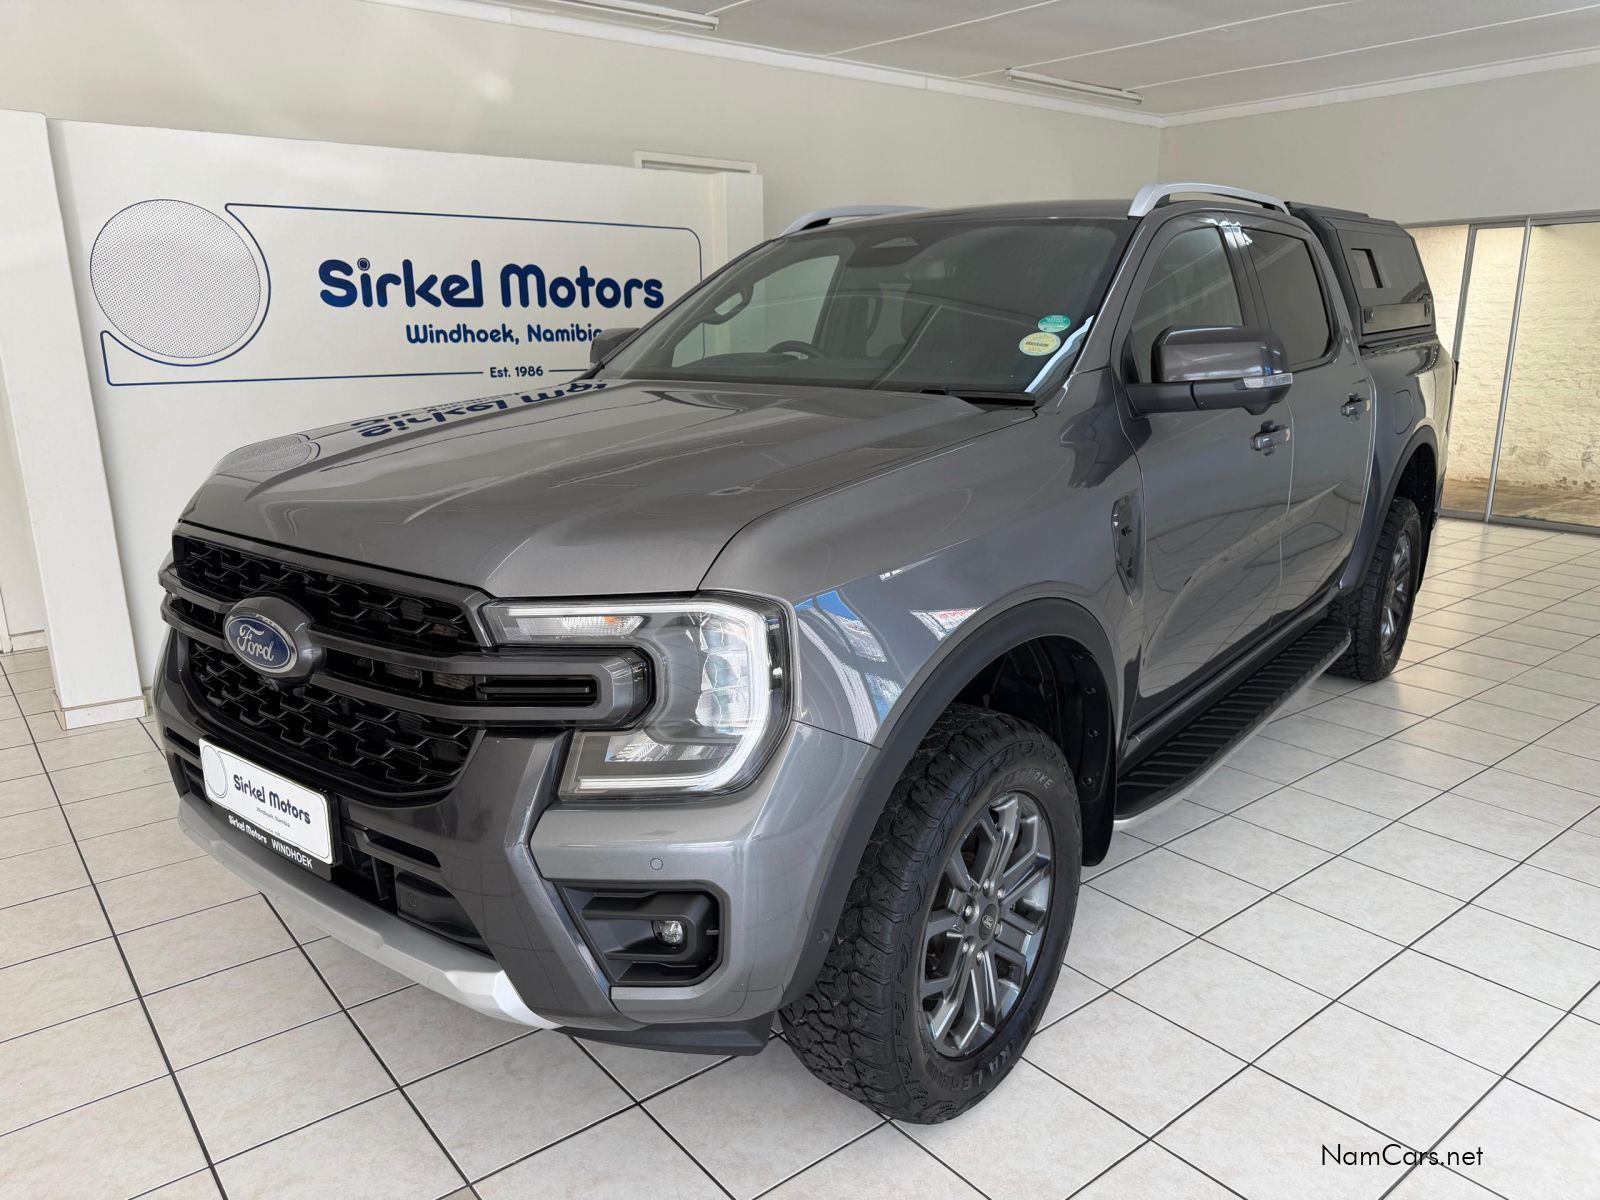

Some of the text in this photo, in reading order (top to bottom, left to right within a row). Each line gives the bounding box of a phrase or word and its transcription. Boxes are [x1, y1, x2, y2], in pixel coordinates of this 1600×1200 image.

[318, 257, 665, 309] Sirkel Motors
[406, 323, 520, 346] Windhoek,
[489, 365, 544, 378] Est. 1986
[236, 624, 275, 662] Ford
[233, 774, 266, 803] Sirkel
[269, 790, 311, 825] Motors
[228, 814, 246, 832] Sirkel
[246, 824, 267, 844] Motors
[271, 838, 314, 869] WINDHOEK
